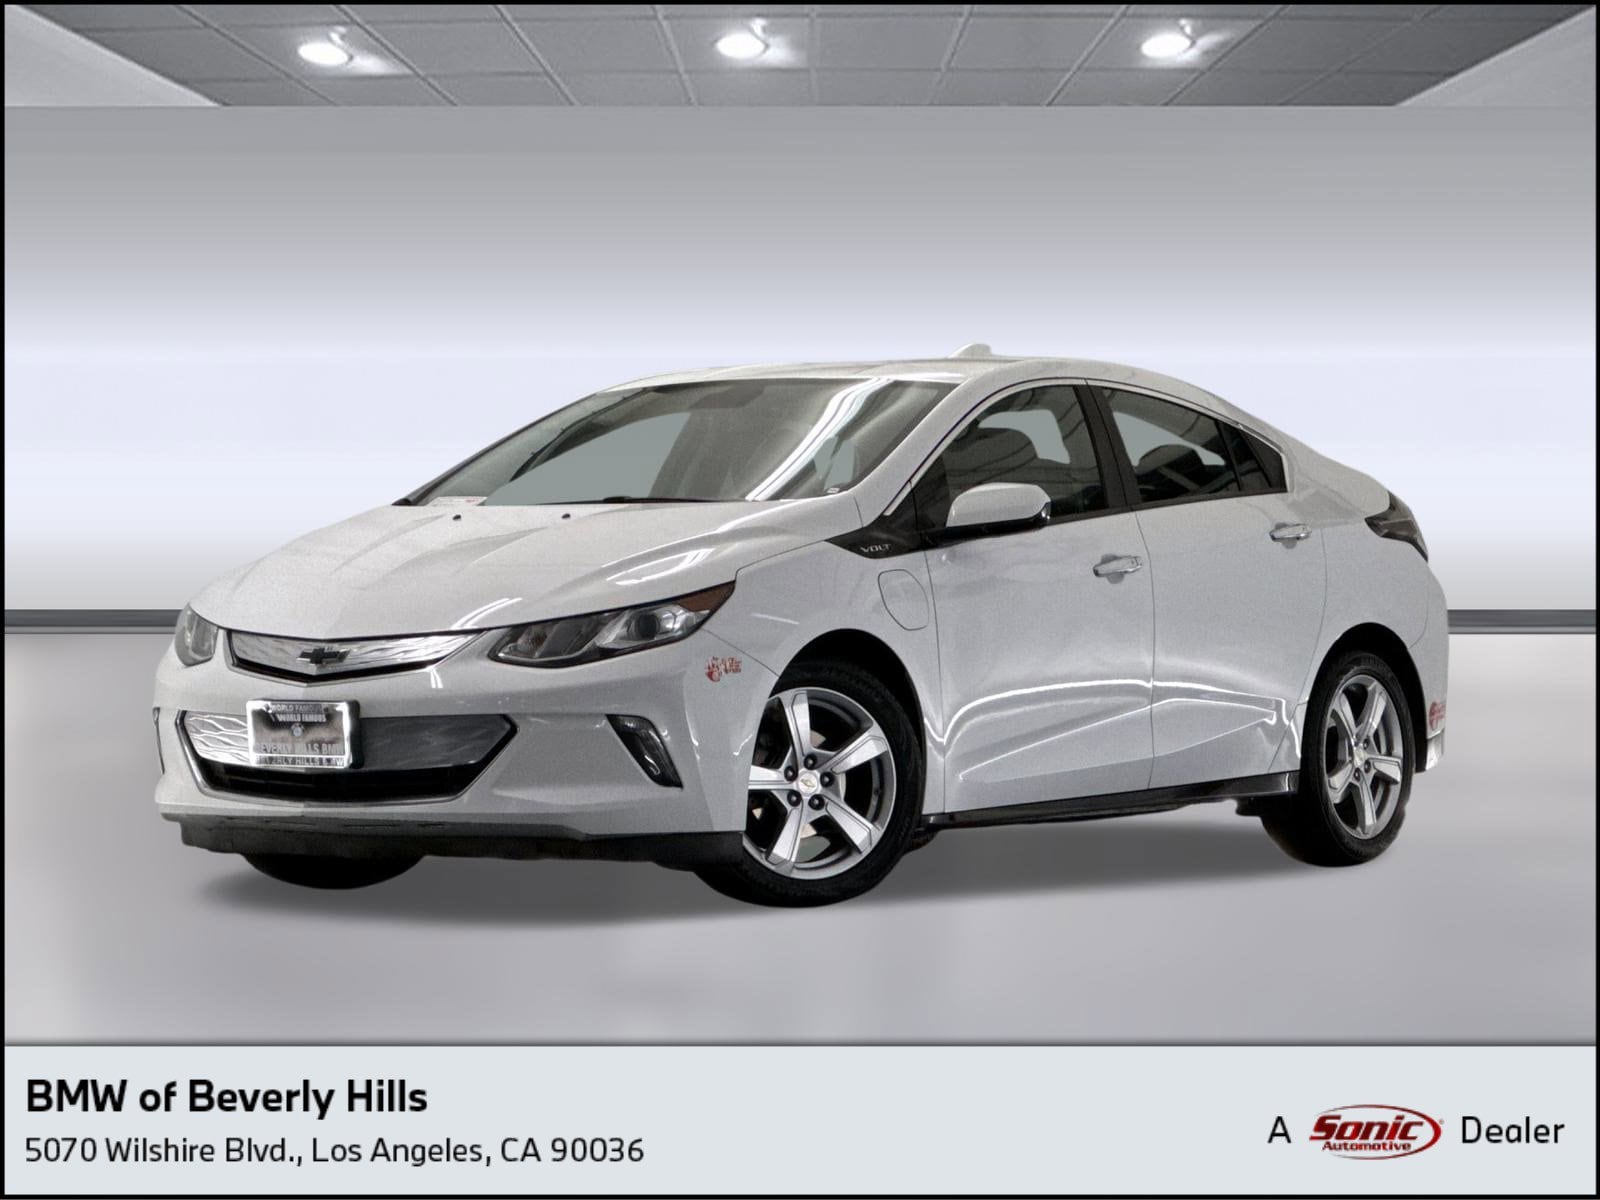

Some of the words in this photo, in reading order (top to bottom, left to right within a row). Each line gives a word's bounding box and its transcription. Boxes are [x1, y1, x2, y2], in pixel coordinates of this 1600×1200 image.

[860, 543, 891, 552] VOLT
[275, 713, 301, 721] WORLD
[302, 714, 327, 722] FAMOUS
